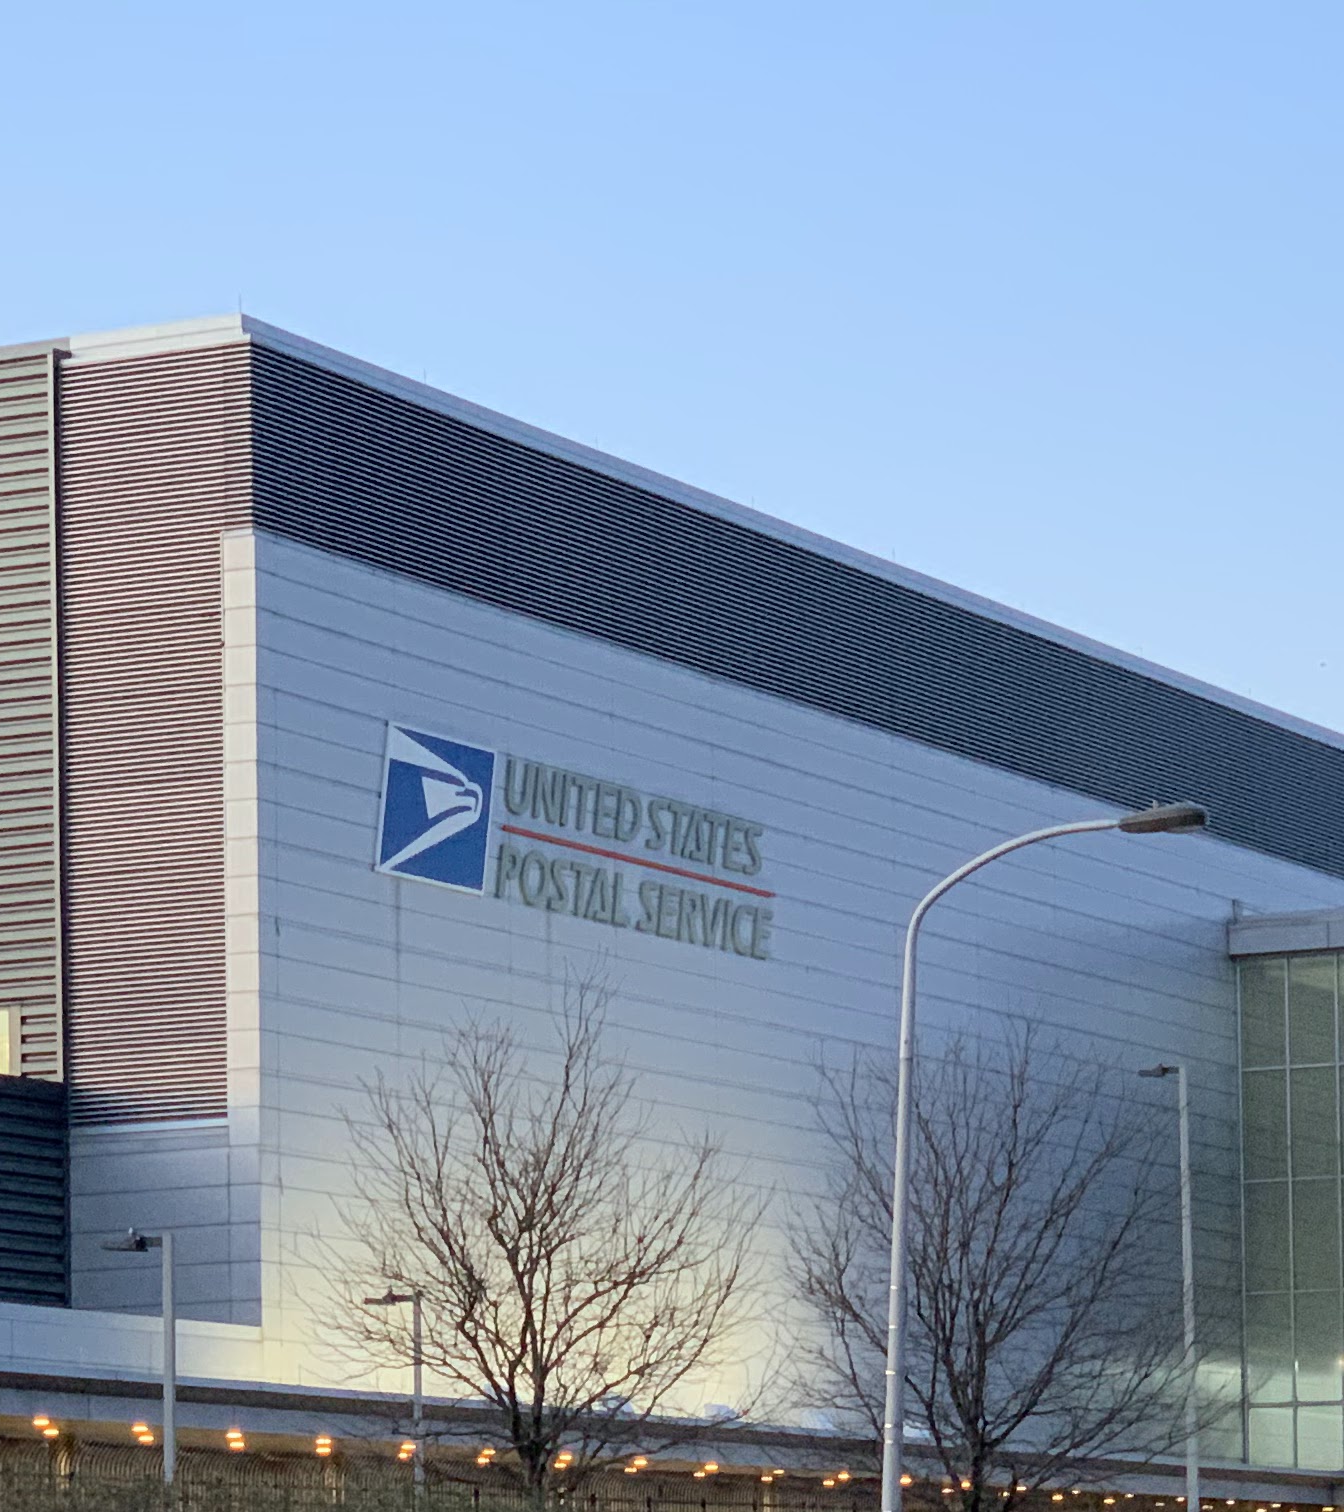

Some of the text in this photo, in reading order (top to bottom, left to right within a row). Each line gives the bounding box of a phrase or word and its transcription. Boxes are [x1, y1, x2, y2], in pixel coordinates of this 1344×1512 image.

[504, 758, 763, 875] UNITED STATES
[494, 844, 774, 960] POSTAL SERVICE
